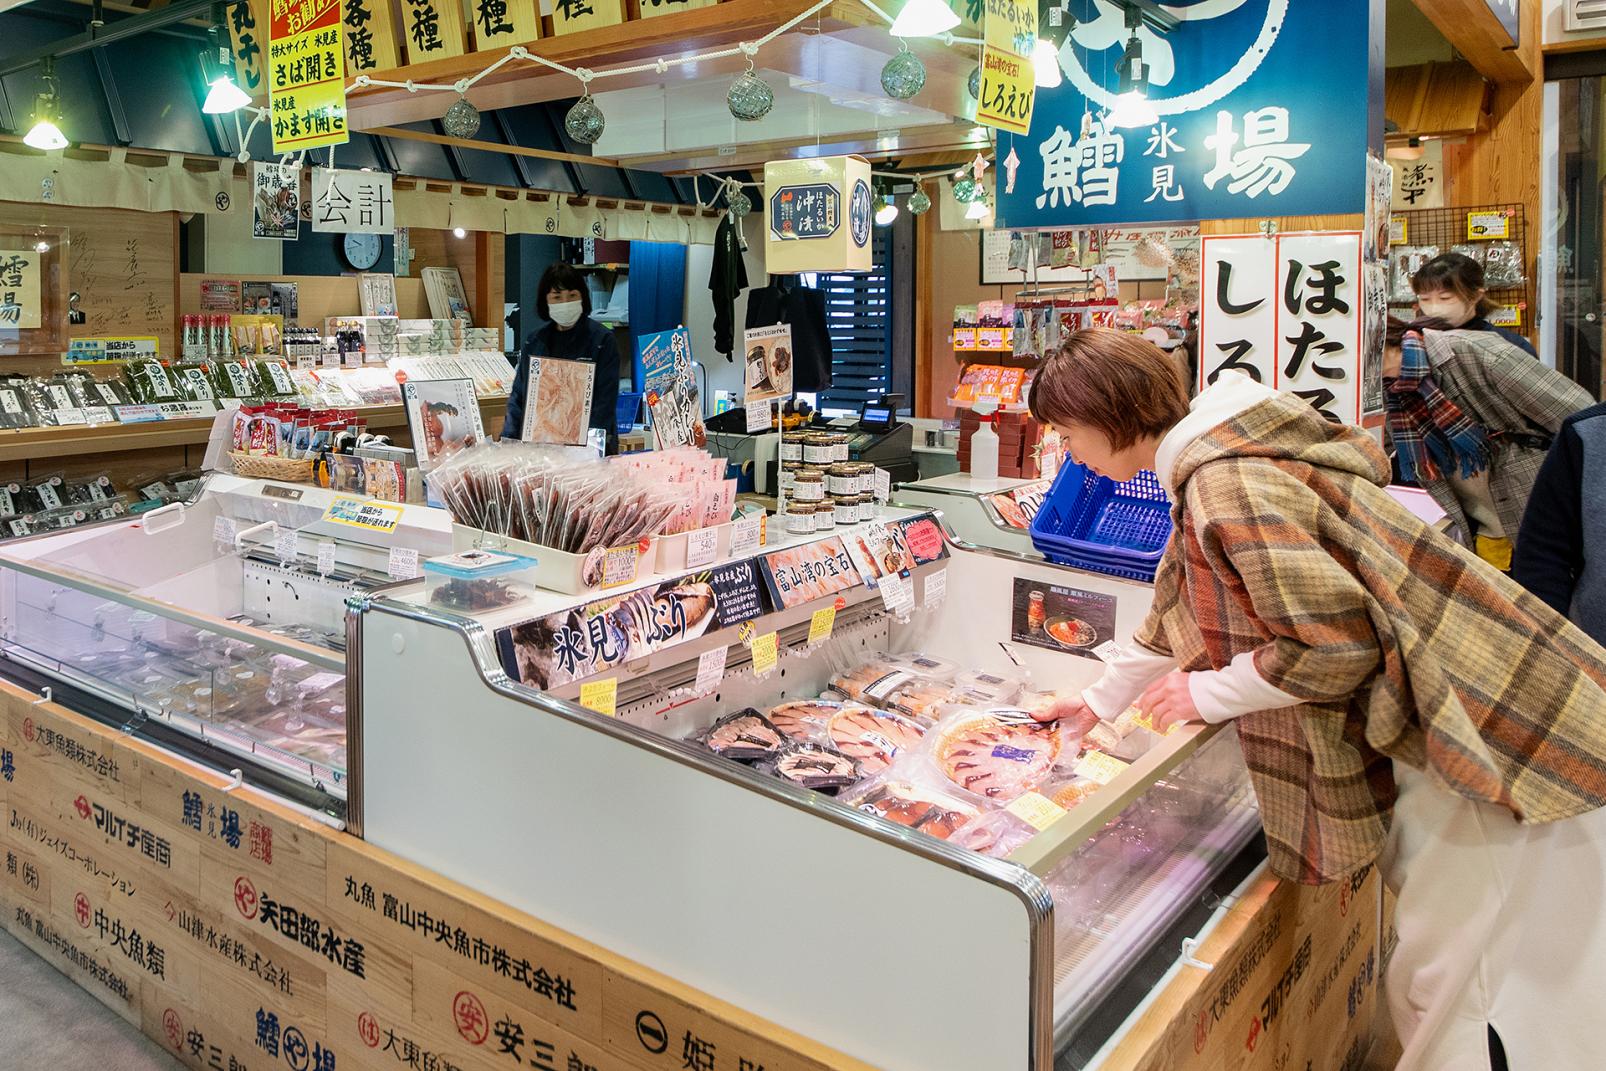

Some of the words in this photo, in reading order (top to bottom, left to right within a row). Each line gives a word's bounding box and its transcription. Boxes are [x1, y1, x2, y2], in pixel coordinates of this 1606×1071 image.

[314, 29, 338, 49] 氷見産
[274, 51, 336, 87] さば開き
[273, 96, 296, 112] 氷見産
[981, 77, 1034, 119] しろえび
[274, 105, 345, 139] かます開き
[315, 182, 392, 227] 会計
[796, 190, 815, 232] 沖漬
[816, 191, 825, 231] ほたるいか
[106, 339, 136, 351] 当店から
[671, 332, 695, 446] 氷見ぶりカレー
[775, 552, 850, 593] 富山湾の宝石
[36, 725, 120, 782] 大東魚類株式会社
[93, 801, 172, 868] マルイチ産商
[93, 908, 166, 982] 中央魚類
[259, 891, 366, 980] 矢田部水産
[344, 875, 376, 911] 丸魚
[382, 892, 578, 1012] 富山中央魚市株式会社
